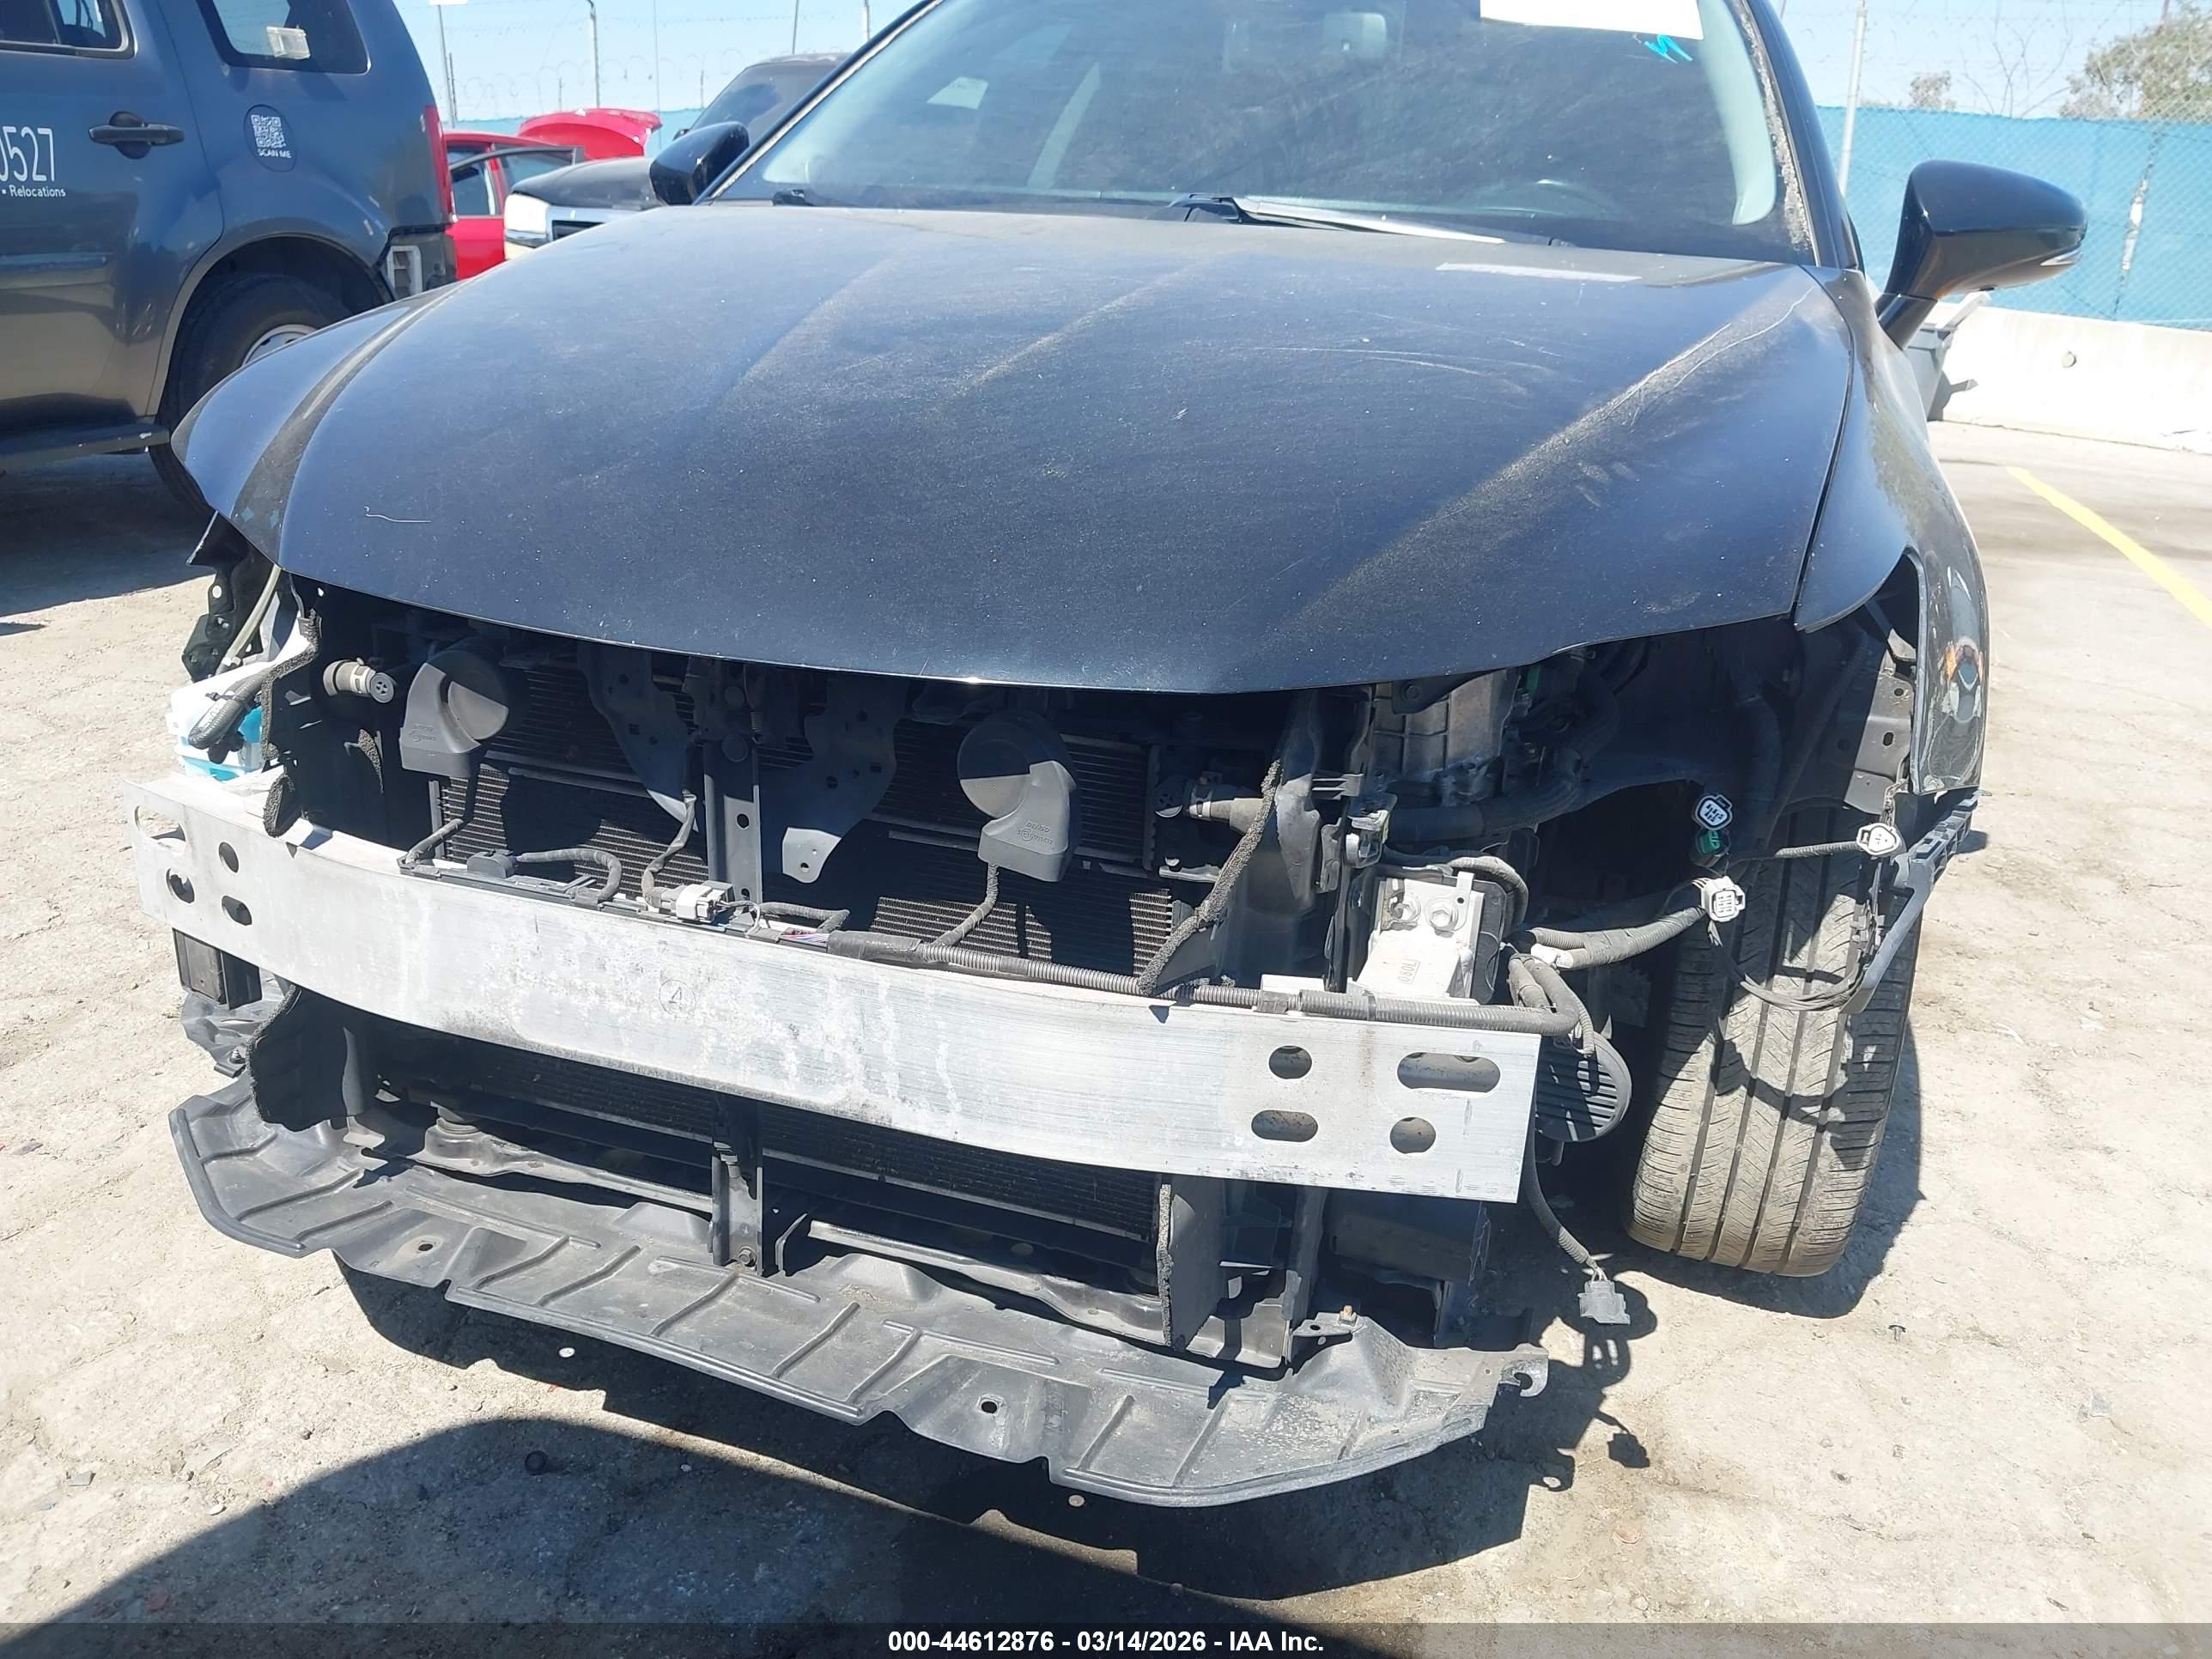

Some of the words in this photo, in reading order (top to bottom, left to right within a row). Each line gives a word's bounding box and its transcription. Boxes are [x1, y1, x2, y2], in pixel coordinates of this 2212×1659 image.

[258, 148, 278, 157] SCAN
[279, 149, 292, 159] ME
[9, 184, 66, 198] Relocations
